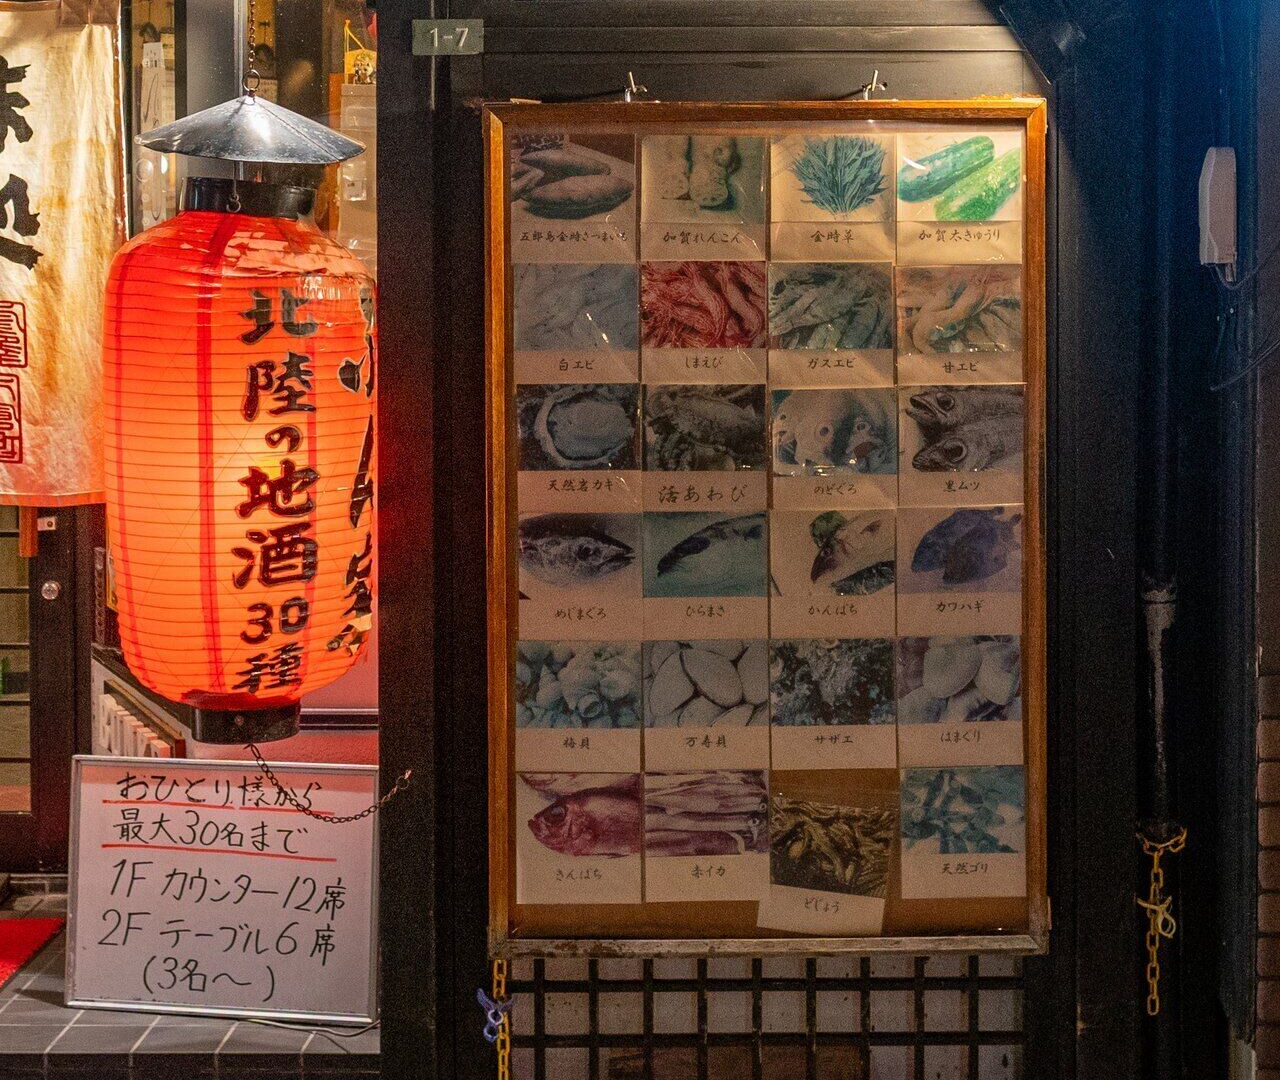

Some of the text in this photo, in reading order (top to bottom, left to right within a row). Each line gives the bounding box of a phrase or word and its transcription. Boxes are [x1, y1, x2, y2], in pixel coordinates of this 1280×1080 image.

[430, 27, 469, 47] 1-7
[810, 229, 854, 244] 金時草
[918, 228, 1001, 243] 加賀太きゅうり
[558, 358, 594, 371] 白エビ
[684, 356, 723, 369] しまえび
[807, 357, 855, 369] ガスエビ
[942, 361, 979, 373] 甘エビ
[231, 287, 318, 695] 北陸の地酒30種
[658, 484, 748, 504] 活あわび
[813, 482, 858, 496] のどぐろ
[936, 600, 986, 613] カワハギ
[814, 733, 854, 745] サザエ
[116, 771, 323, 808] おひとり様から
[112, 808, 309, 854] 最大30名まで
[110, 858, 347, 921] 1F カウンター12席
[98, 908, 337, 966] 2F テーブル6席
